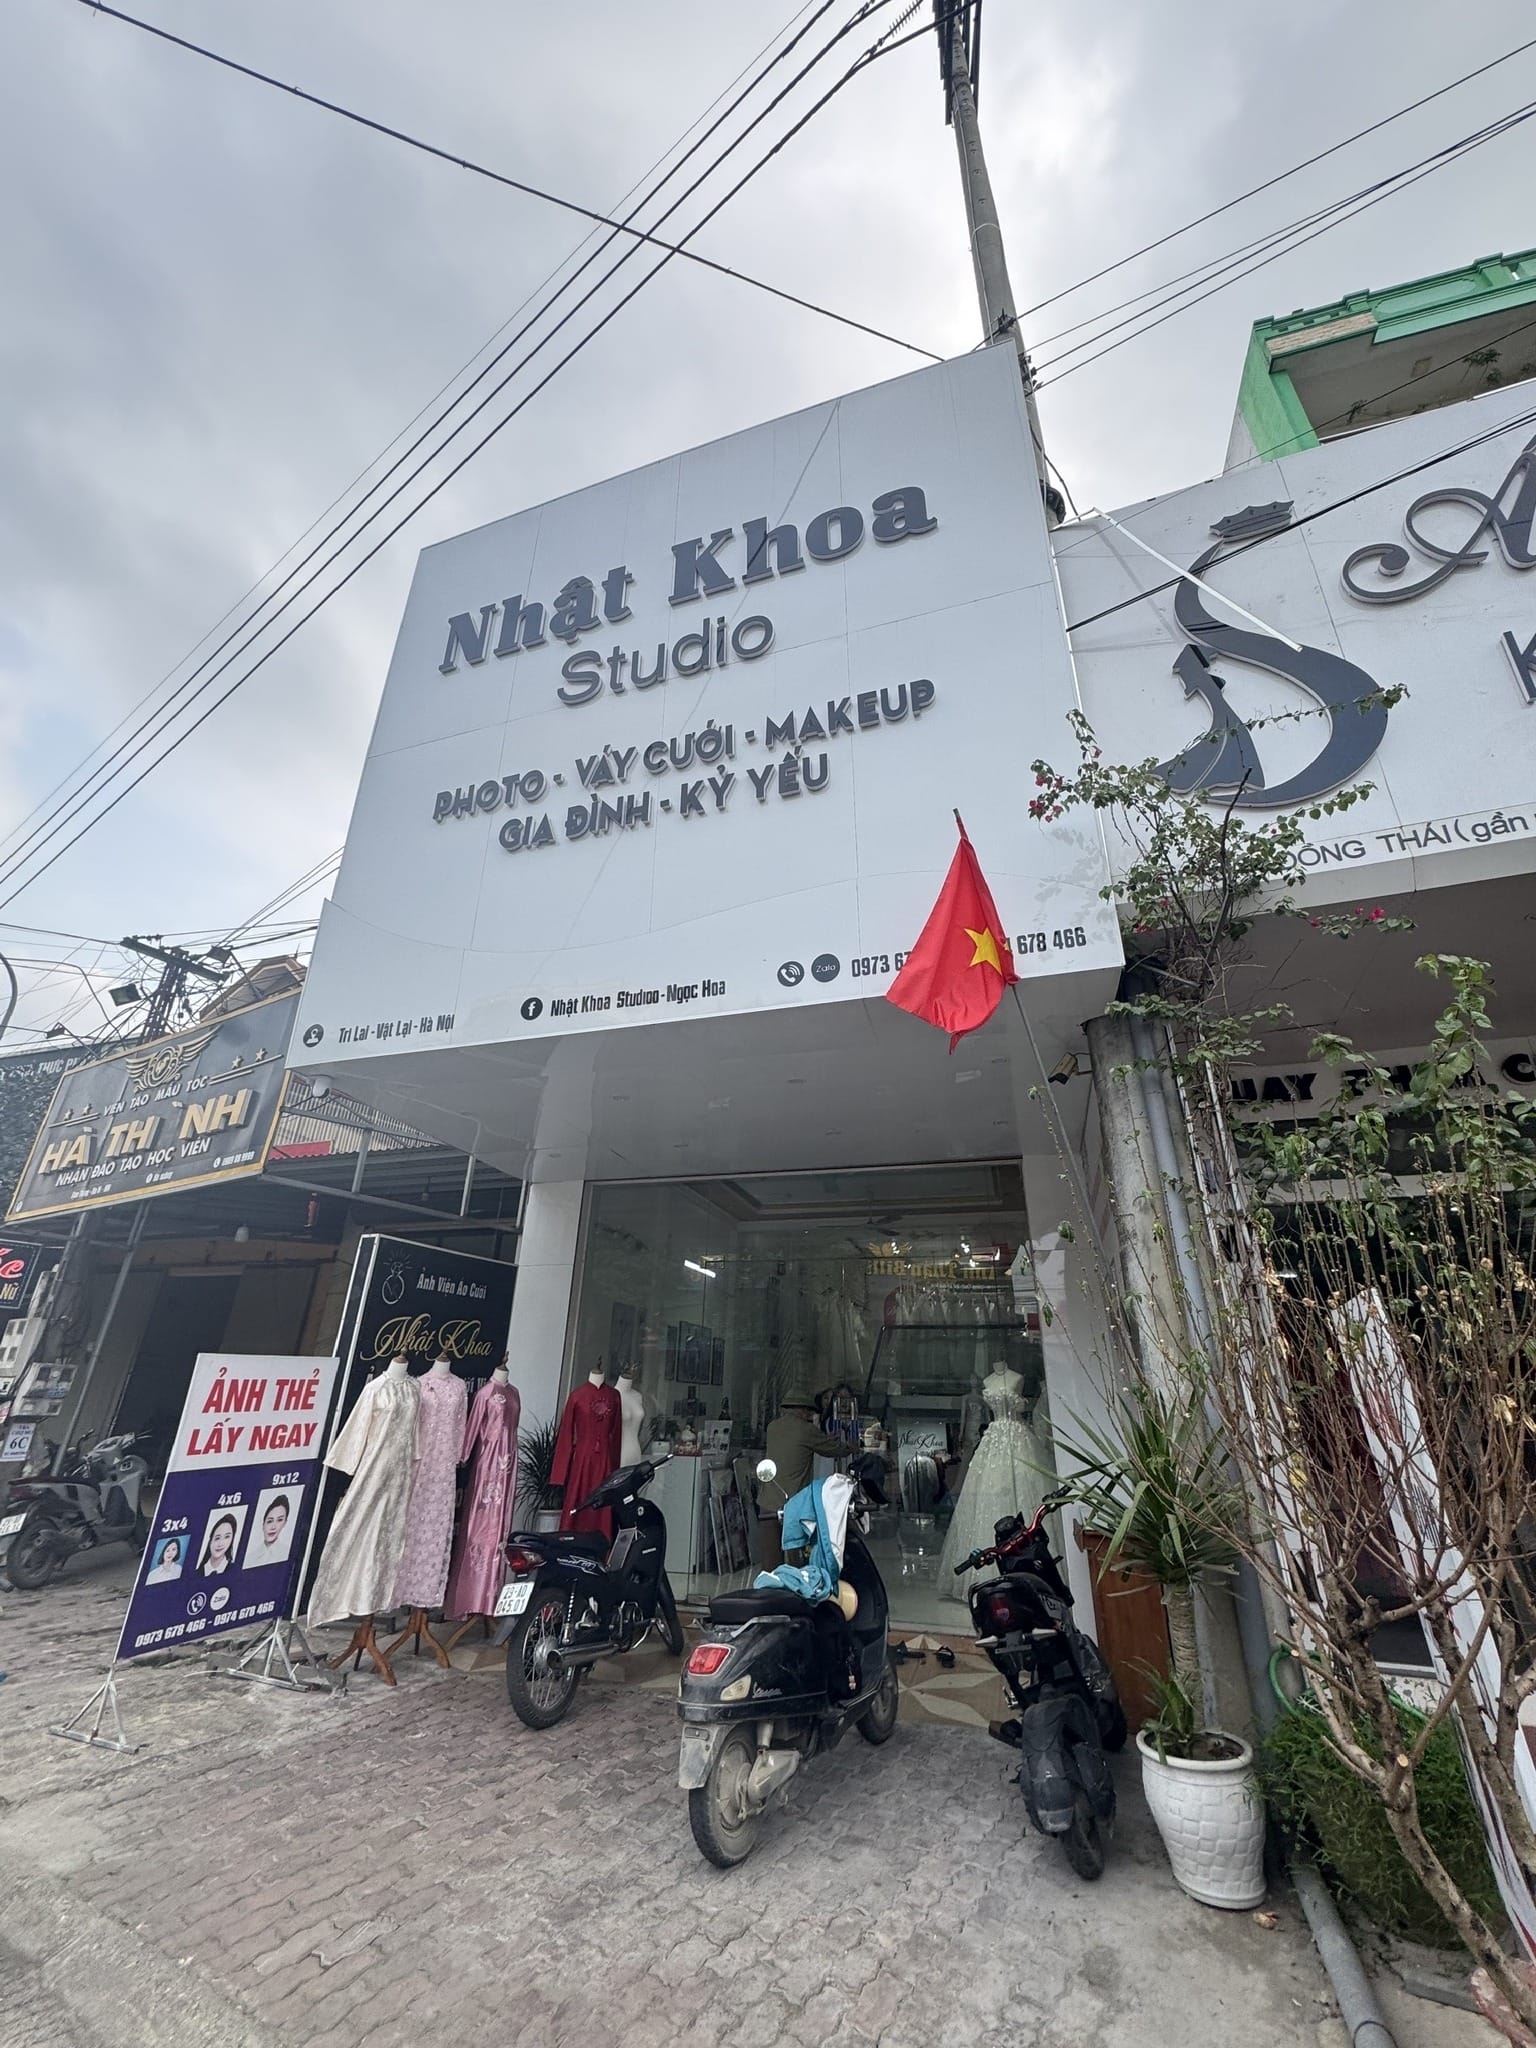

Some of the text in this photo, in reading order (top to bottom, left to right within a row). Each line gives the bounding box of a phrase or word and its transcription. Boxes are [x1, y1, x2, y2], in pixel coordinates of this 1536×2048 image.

[438, 486, 938, 674] Nhật Khoa
[556, 614, 775, 706] Studio
[433, 769, 547, 823] PHOTO
[575, 744, 638, 789] VÁY
[643, 719, 735, 774] CƯỚI
[765, 679, 936, 750] MAKEUP
[499, 812, 556, 853] GIA
[565, 791, 651, 840] ĐÌNH
[680, 764, 736, 818] KỶ
[747, 745, 830, 803] YẾU
[1376, 822, 1451, 853] THÁI
[815, 963, 836, 973] Zalo
[851, 954, 890, 977] 0973
[1016, 932, 1047, 955] 678
[1052, 926, 1087, 950] 466
[551, 998, 578, 1018] Nhật
[581, 995, 611, 1013] Khoa
[666, 983, 698, 1004] Ngọc
[702, 979, 726, 998] Hoa
[395, 1019, 413, 1039] Lại
[419, 1016, 434, 1033] Hà
[436, 1014, 455, 1033] Nội
[38, 1126, 94, 1174] HÀ
[145, 1147, 176, 1168] HỌC
[360, 1313, 493, 1361] Nhật Khoa
[202, 1366, 268, 1413] ẢNH
[273, 1368, 320, 1411] THẺ
[186, 1417, 319, 1456] LẤY NGAY
[218, 1492, 242, 1506] 4x6
[272, 1472, 300, 1485] 9x12
[162, 1517, 188, 1532] 3x4
[135, 1629, 164, 1648] 0973
[164, 1623, 185, 1640] 678
[186, 1618, 207, 1633] 466
[213, 1610, 237, 1626] 0974
[238, 1604, 256, 1620] 678
[256, 1601, 275, 1615] 466
